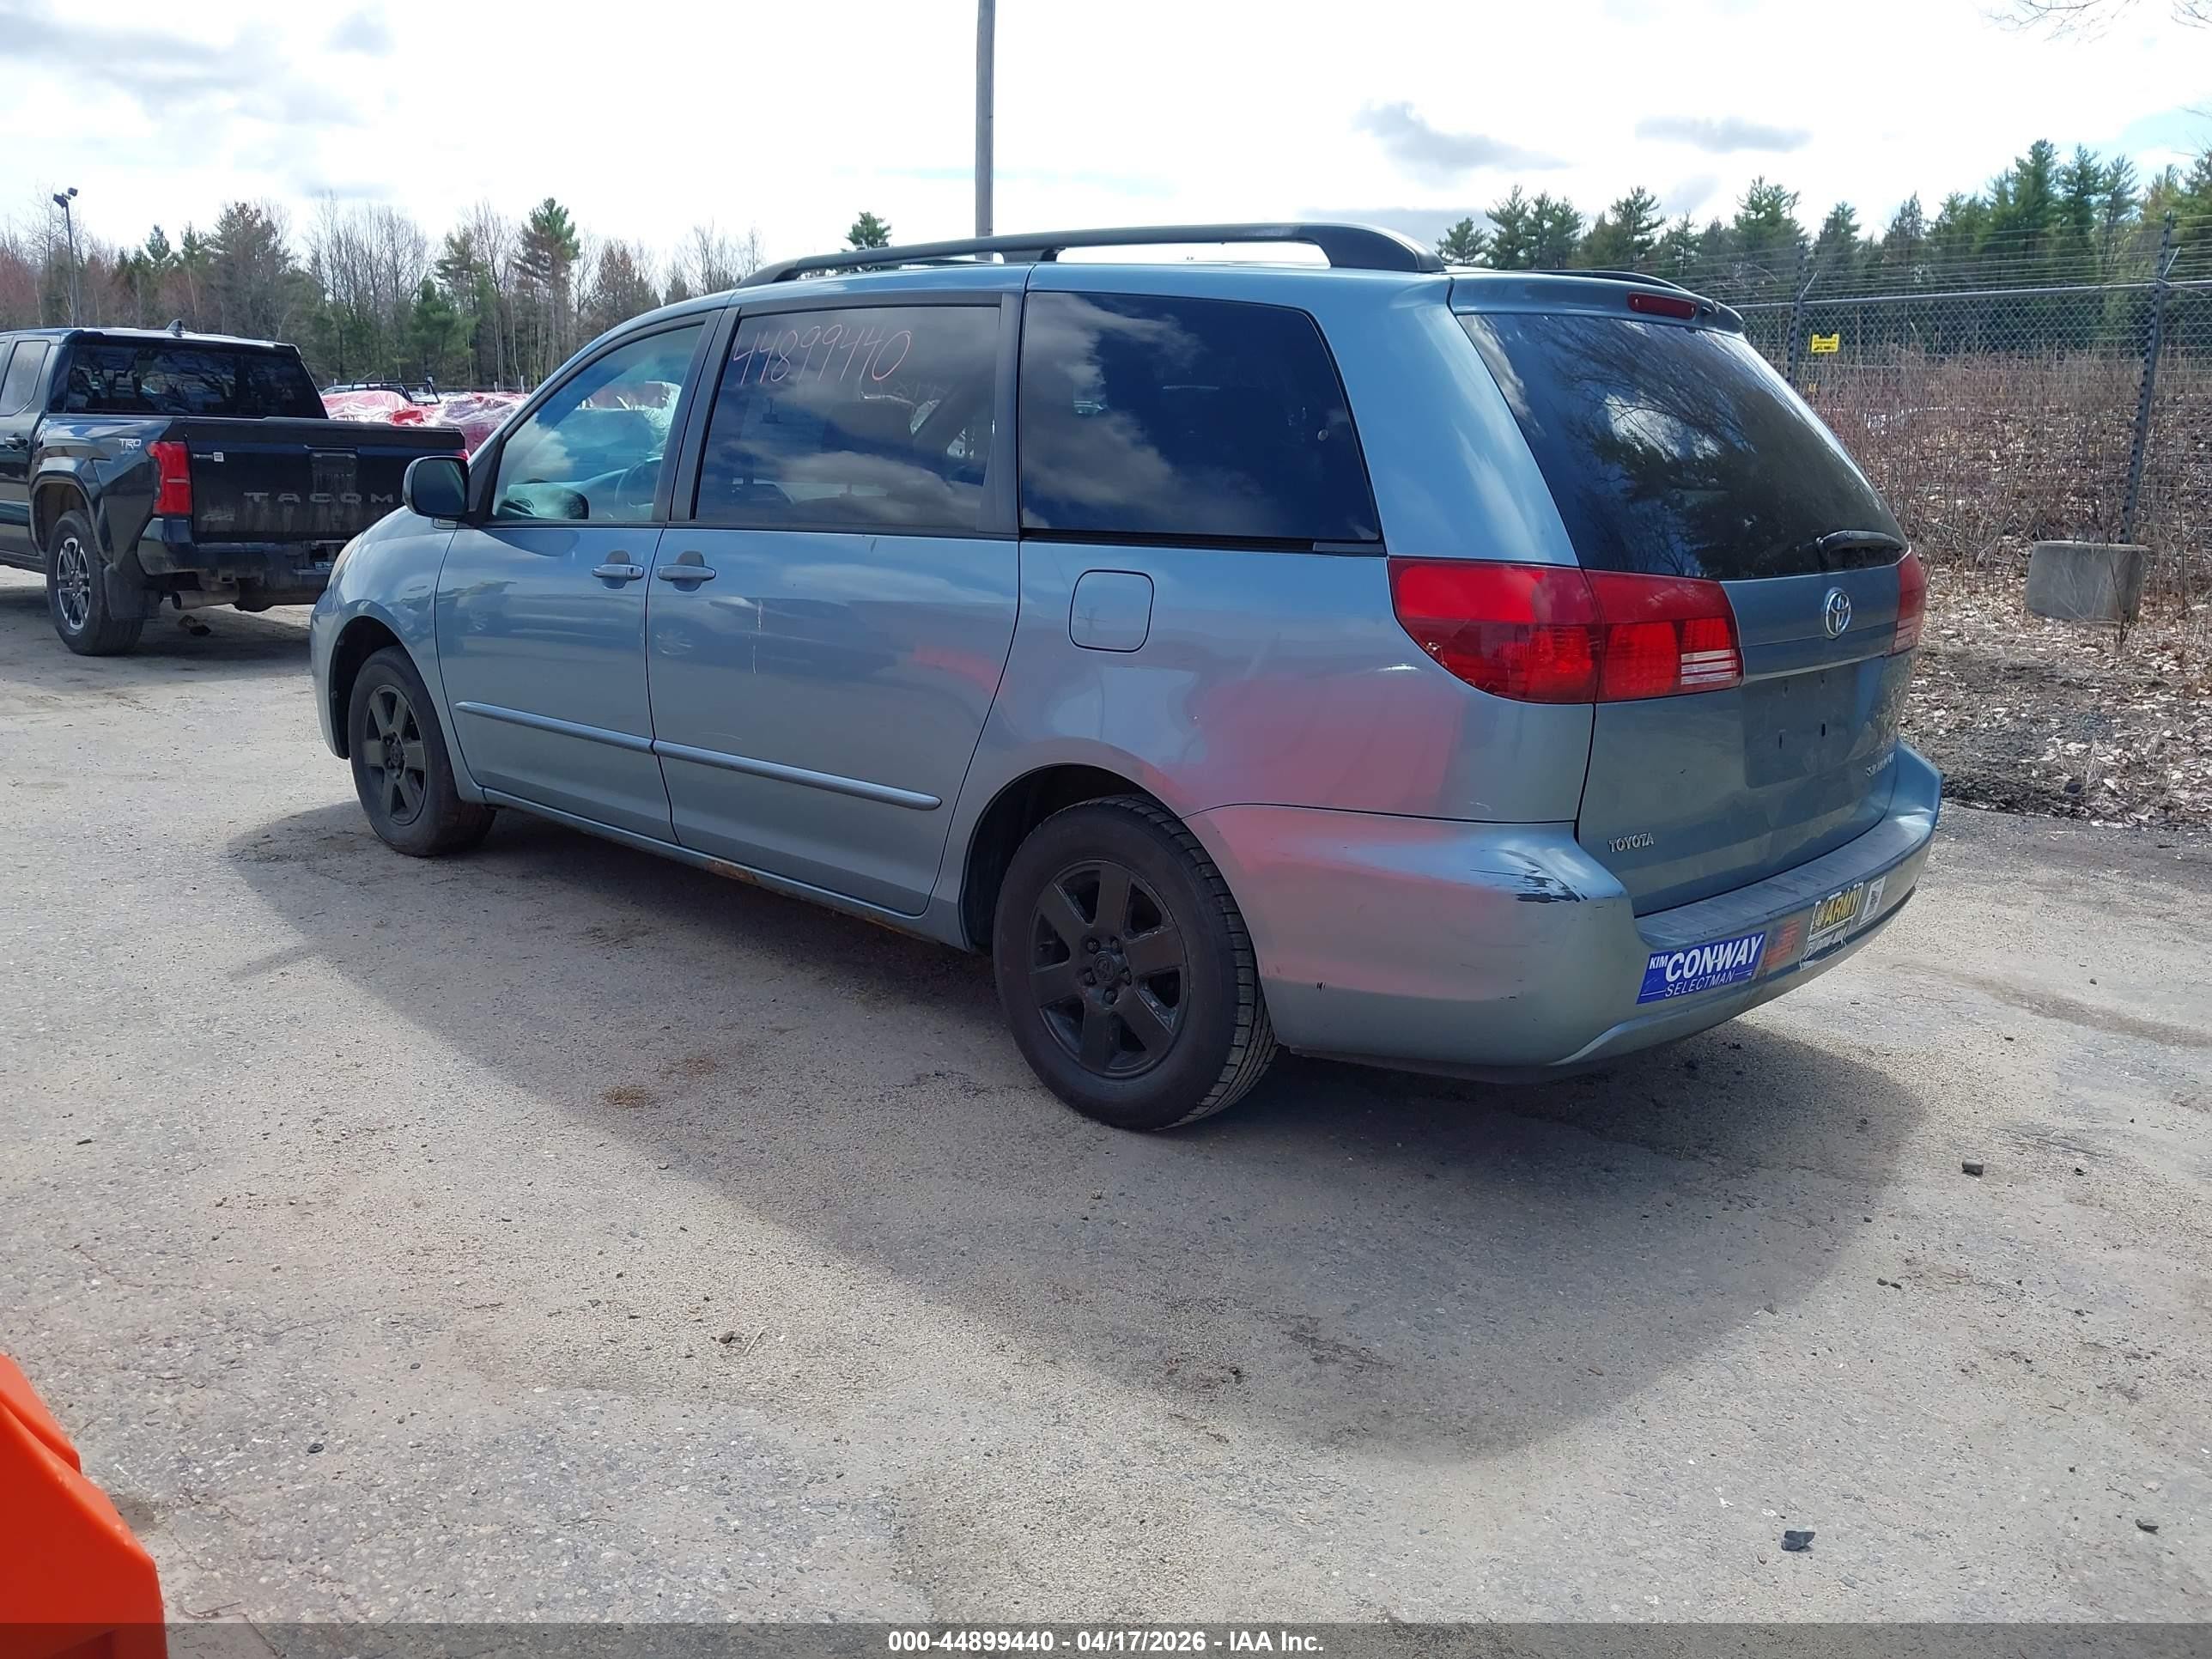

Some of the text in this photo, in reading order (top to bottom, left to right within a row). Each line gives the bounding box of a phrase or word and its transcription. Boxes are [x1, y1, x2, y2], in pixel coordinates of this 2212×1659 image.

[733, 324, 912, 386] 44899440
[118, 438, 142, 449] TRD
[243, 492, 404, 503] TACOM
[1607, 832, 1655, 853] TOYOTA
[1823, 887, 1863, 928] ARMY
[1649, 933, 1765, 982] KIM CONWAY
[1664, 969, 1736, 998] SELECTMAN
